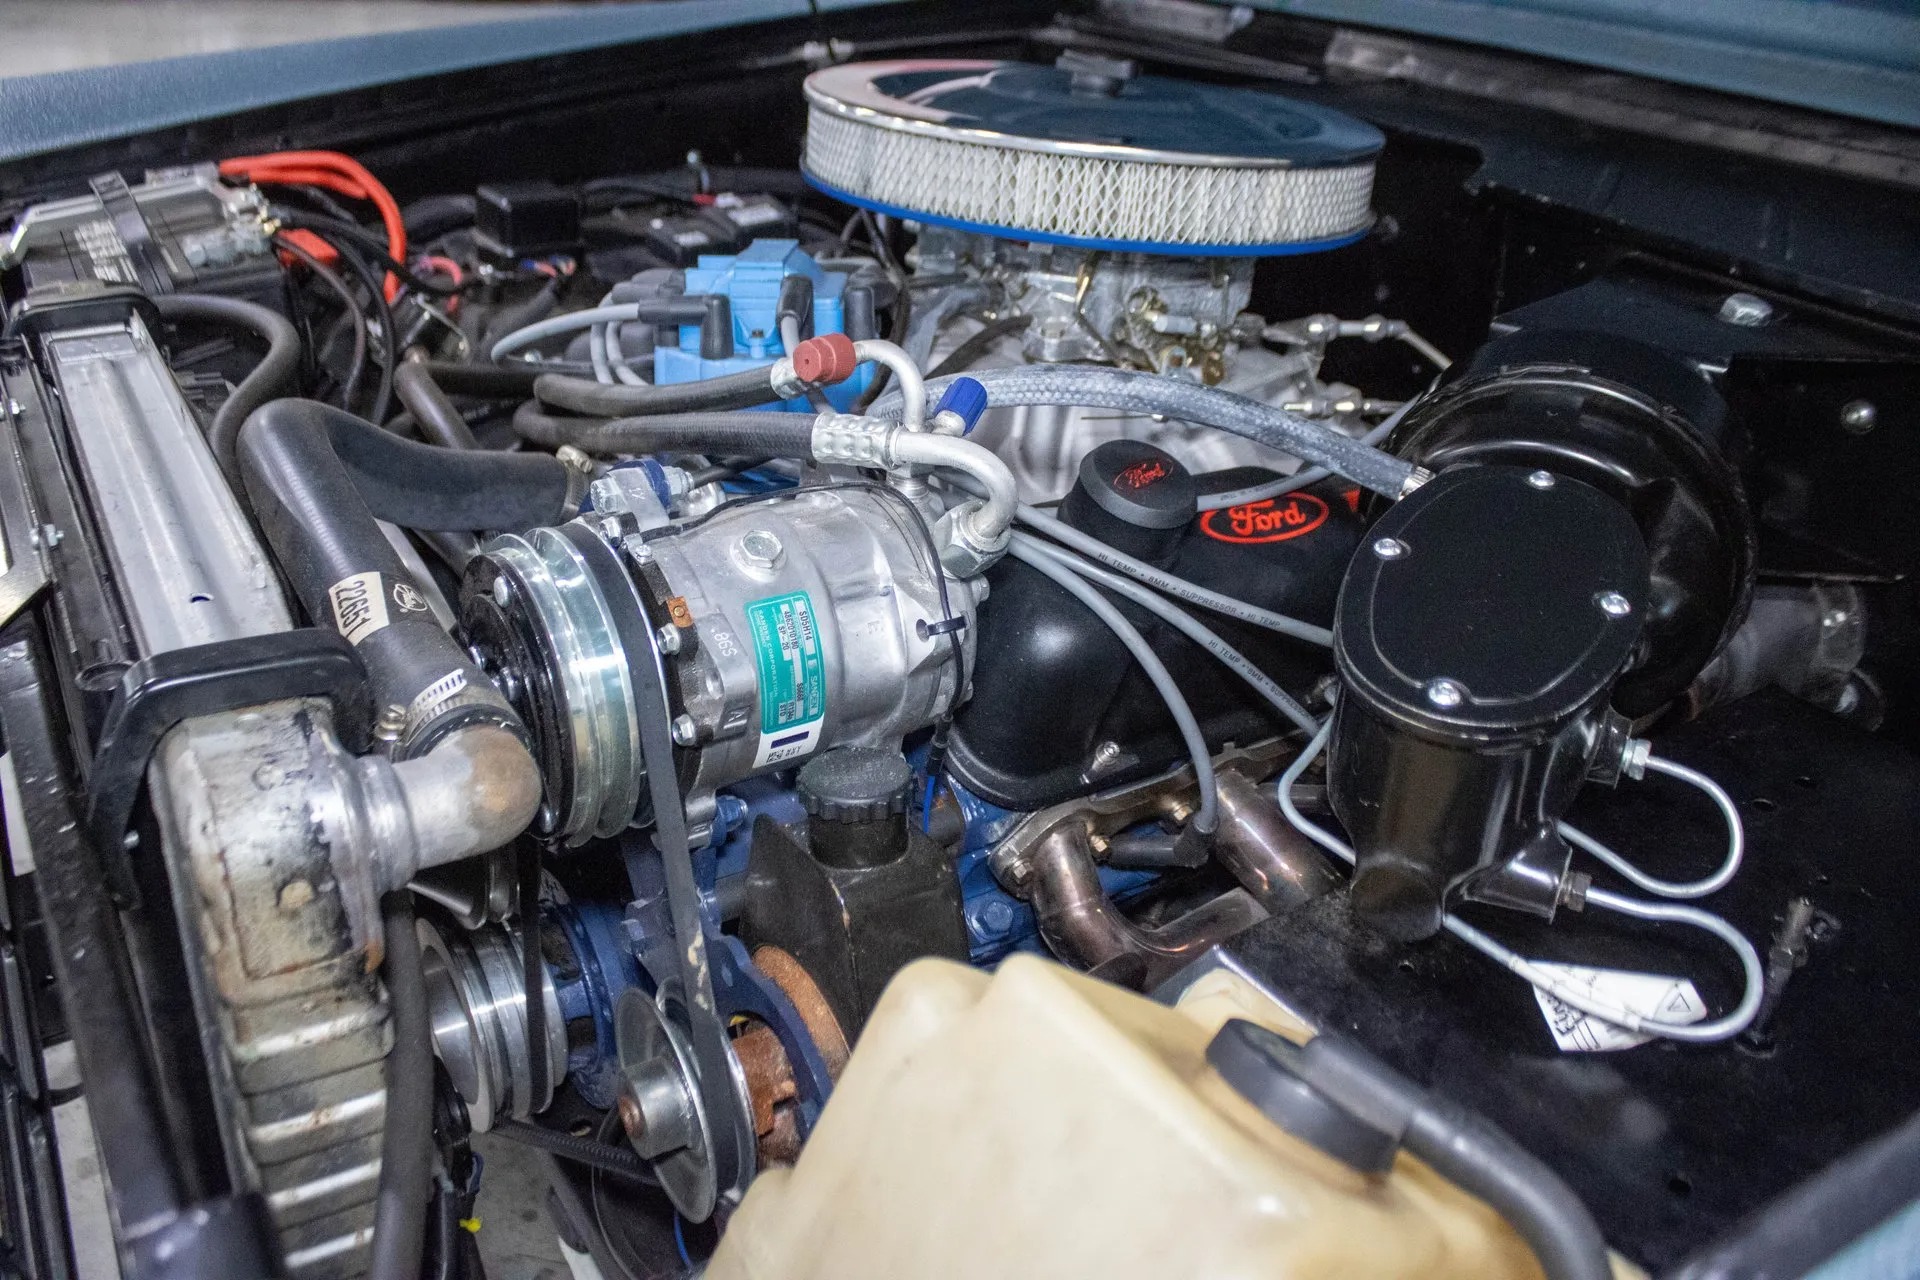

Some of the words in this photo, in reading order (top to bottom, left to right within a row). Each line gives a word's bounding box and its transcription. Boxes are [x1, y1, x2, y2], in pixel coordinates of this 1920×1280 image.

[1125, 463, 1165, 488] Ford
[1229, 499, 1306, 536] Ford
[1098, 552, 1108, 561] HI
[1112, 559, 1137, 576] TEMP
[1180, 588, 1238, 616] SUPPRESSOR
[1247, 611, 1257, 622] HI
[1259, 615, 1282, 628] TEMP
[335, 580, 372, 639] 22651
[798, 610, 813, 641] SD5H14
[767, 643, 782, 697] CORPORATION
[1208, 640, 1218, 649] HI
[1220, 647, 1241, 664] TEMP
